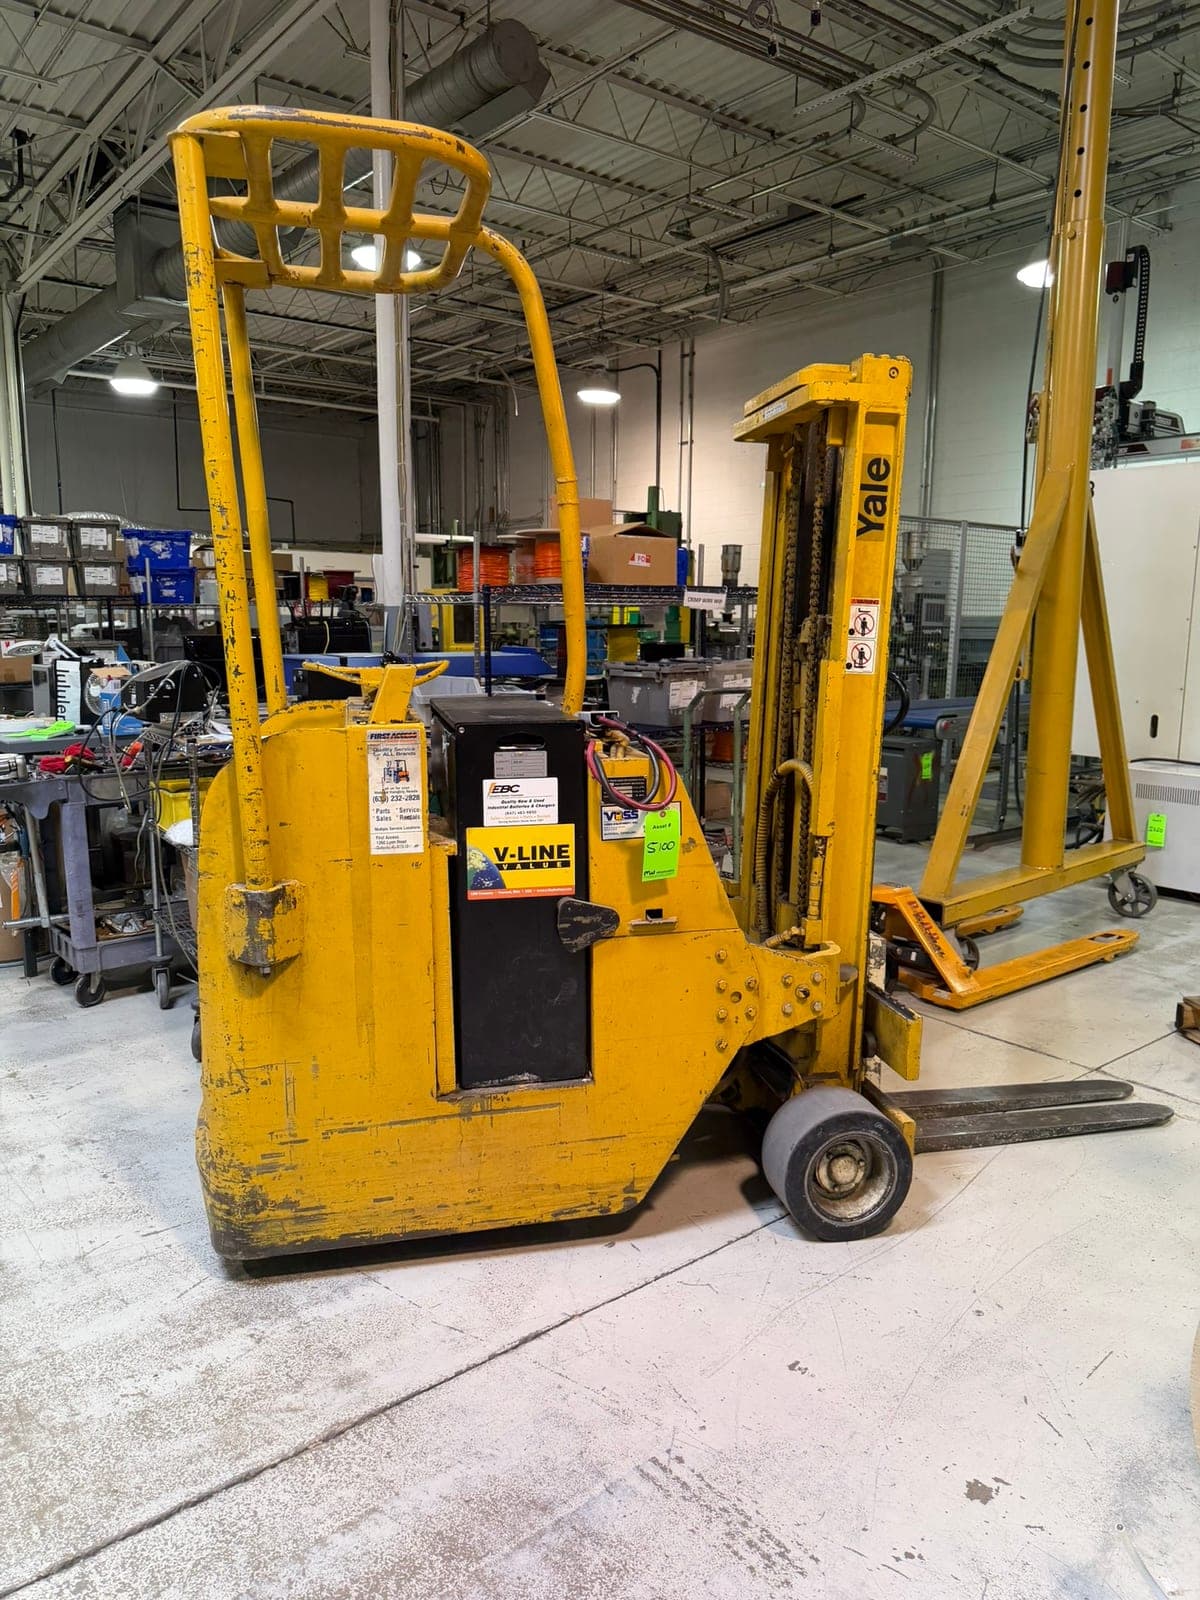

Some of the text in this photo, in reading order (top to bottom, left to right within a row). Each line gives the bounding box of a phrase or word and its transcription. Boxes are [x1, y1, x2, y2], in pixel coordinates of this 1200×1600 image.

[856, 457, 891, 537] Yale
[491, 784, 521, 794] EBC
[603, 810, 639, 822] VOSS
[493, 844, 570, 862] V-LINE
[502, 861, 563, 871] VALUE
